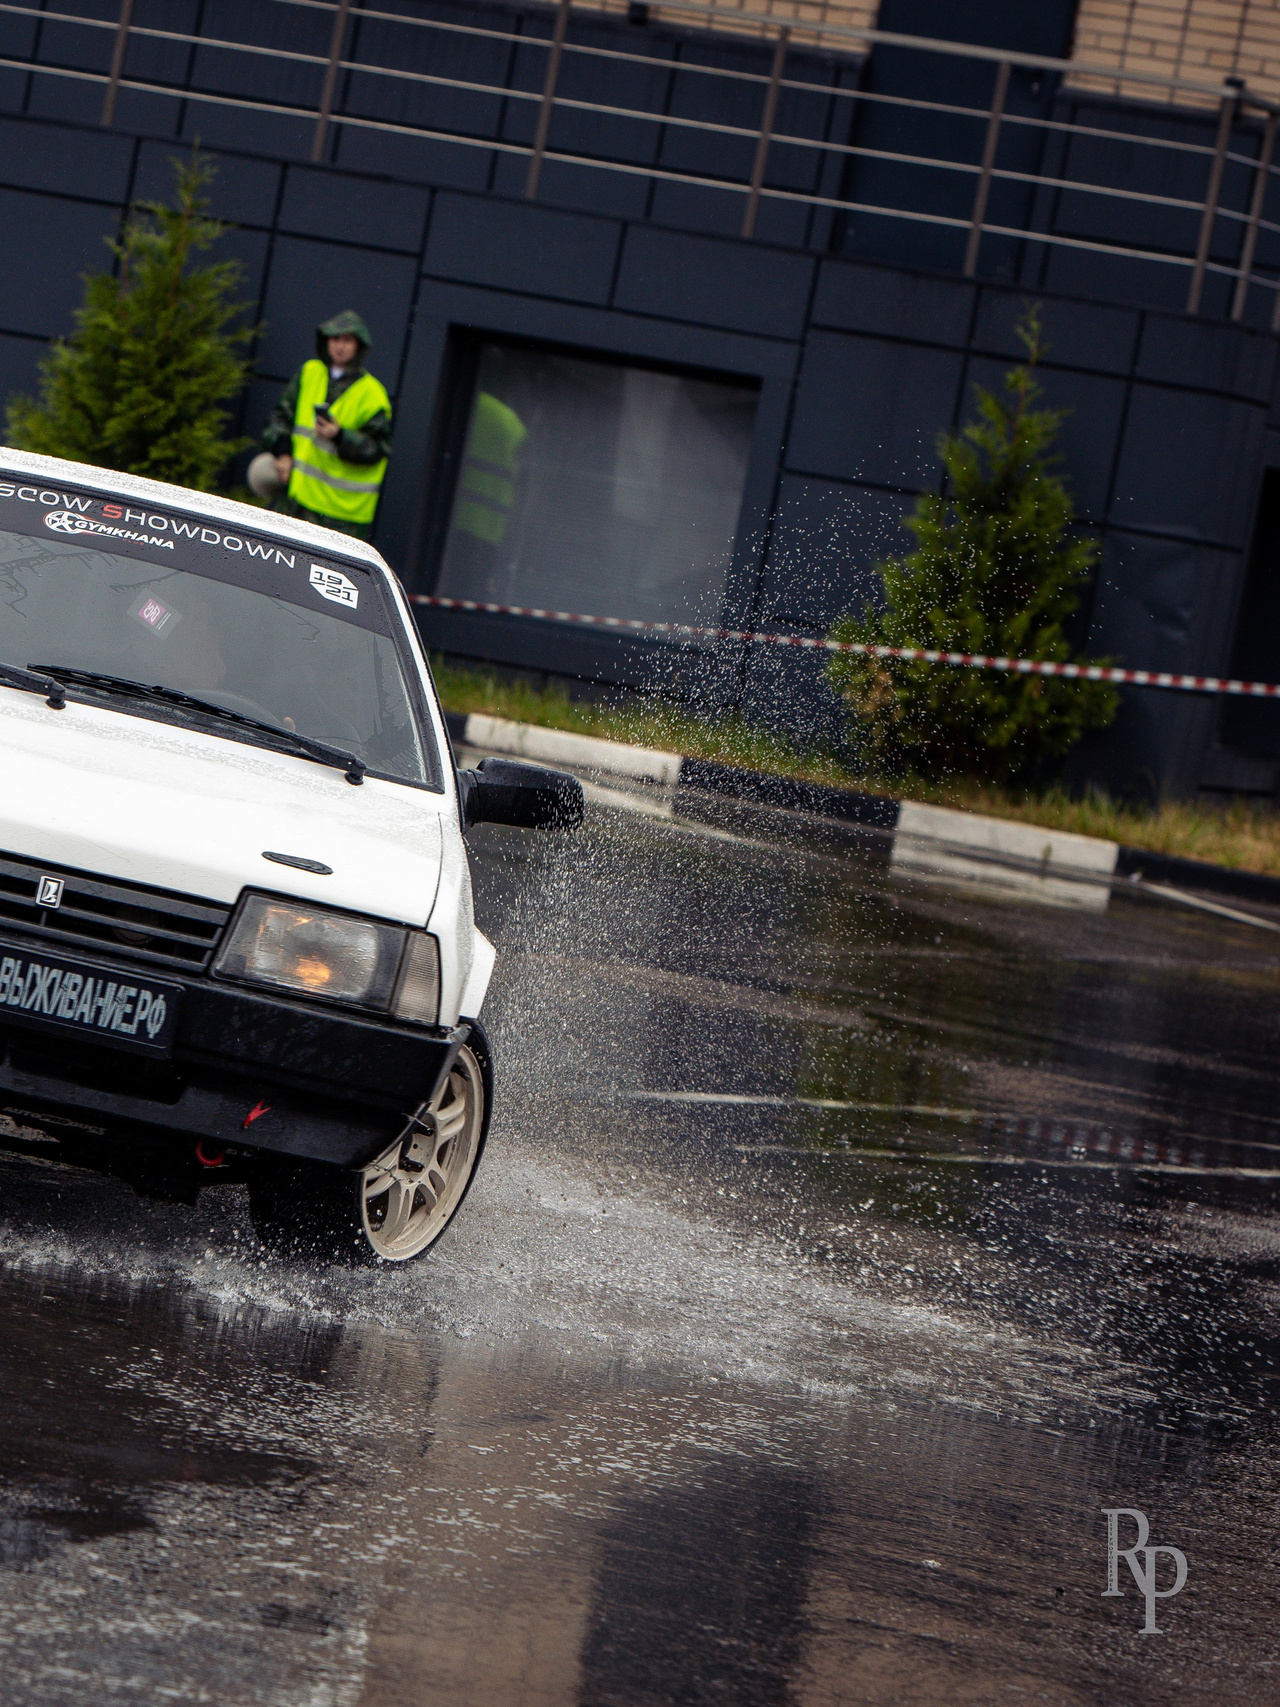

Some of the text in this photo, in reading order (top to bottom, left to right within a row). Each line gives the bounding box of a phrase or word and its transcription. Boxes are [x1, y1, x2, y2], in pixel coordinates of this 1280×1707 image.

[74, 519, 175, 550] GYMKHANA
[102, 504, 296, 569] SHOWDOWN
[313, 570, 343, 586] 19
[325, 584, 354, 602] 21
